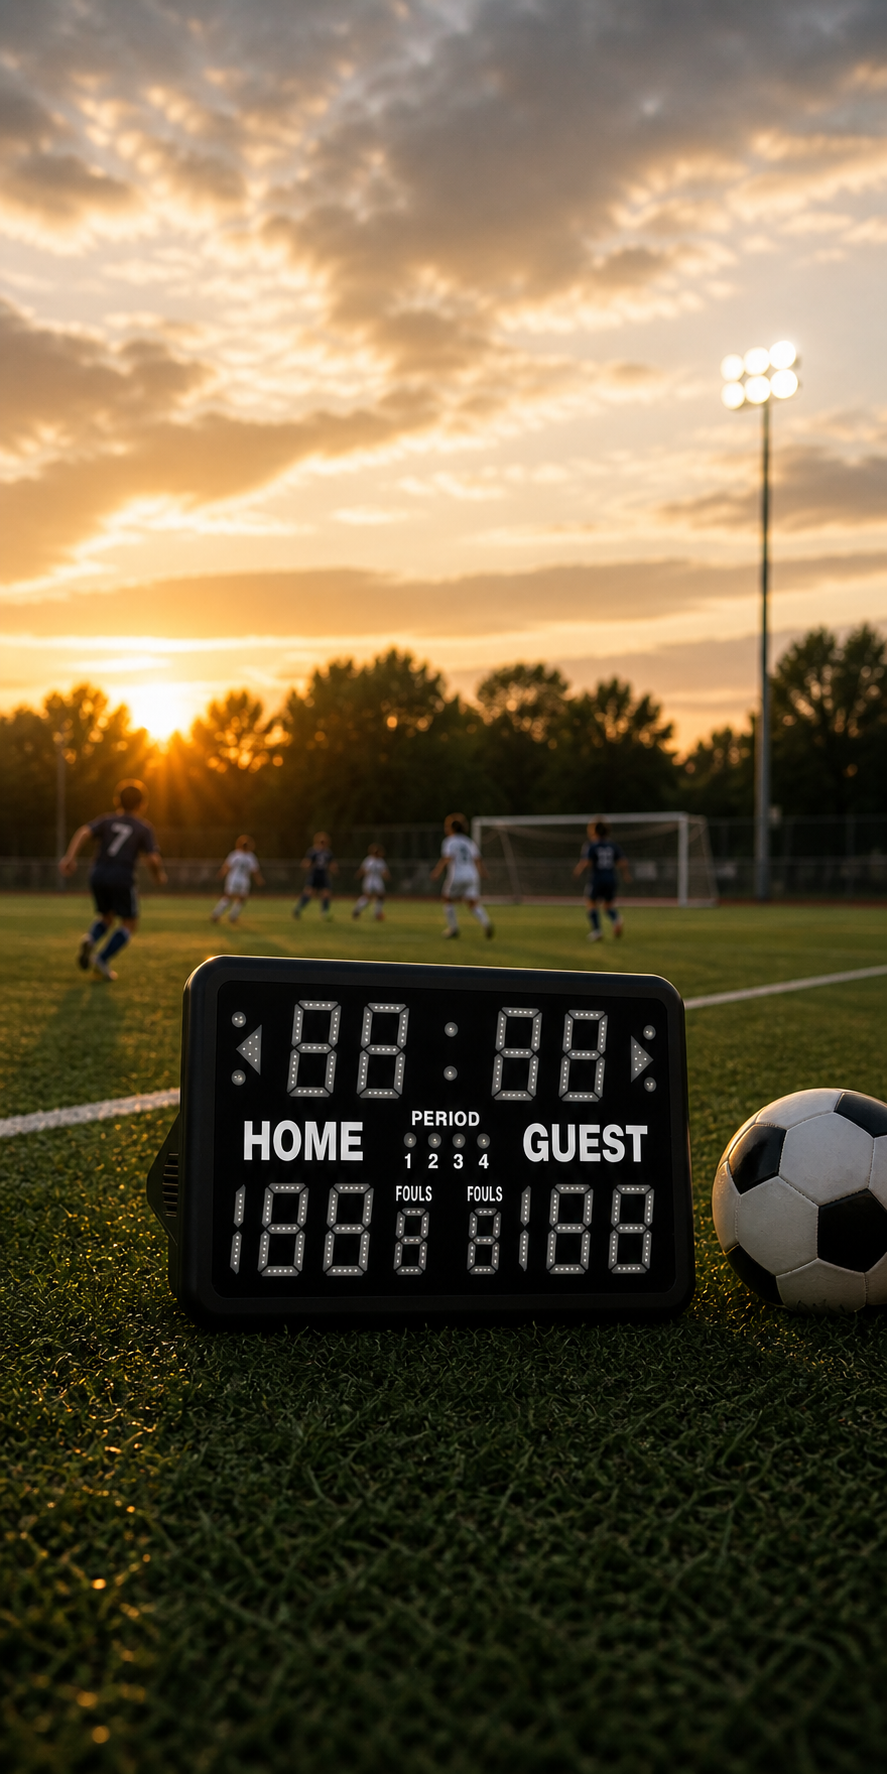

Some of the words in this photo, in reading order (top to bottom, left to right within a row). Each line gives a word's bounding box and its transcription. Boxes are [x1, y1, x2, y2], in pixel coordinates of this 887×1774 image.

[108, 822, 133, 857] 7
[411, 1110, 480, 1127] PERIOD
[243, 1120, 364, 1162] HOME
[522, 1122, 648, 1163] GUEST
[404, 1153, 412, 1169] 1
[428, 1154, 439, 1169] 2
[453, 1154, 464, 1169] 3
[478, 1154, 490, 1169] 4
[395, 1186, 433, 1202] FOULS
[467, 1186, 503, 1202] FOULS
[394, 1208, 430, 1275] 8
[467, 1208, 502, 1275] 8
